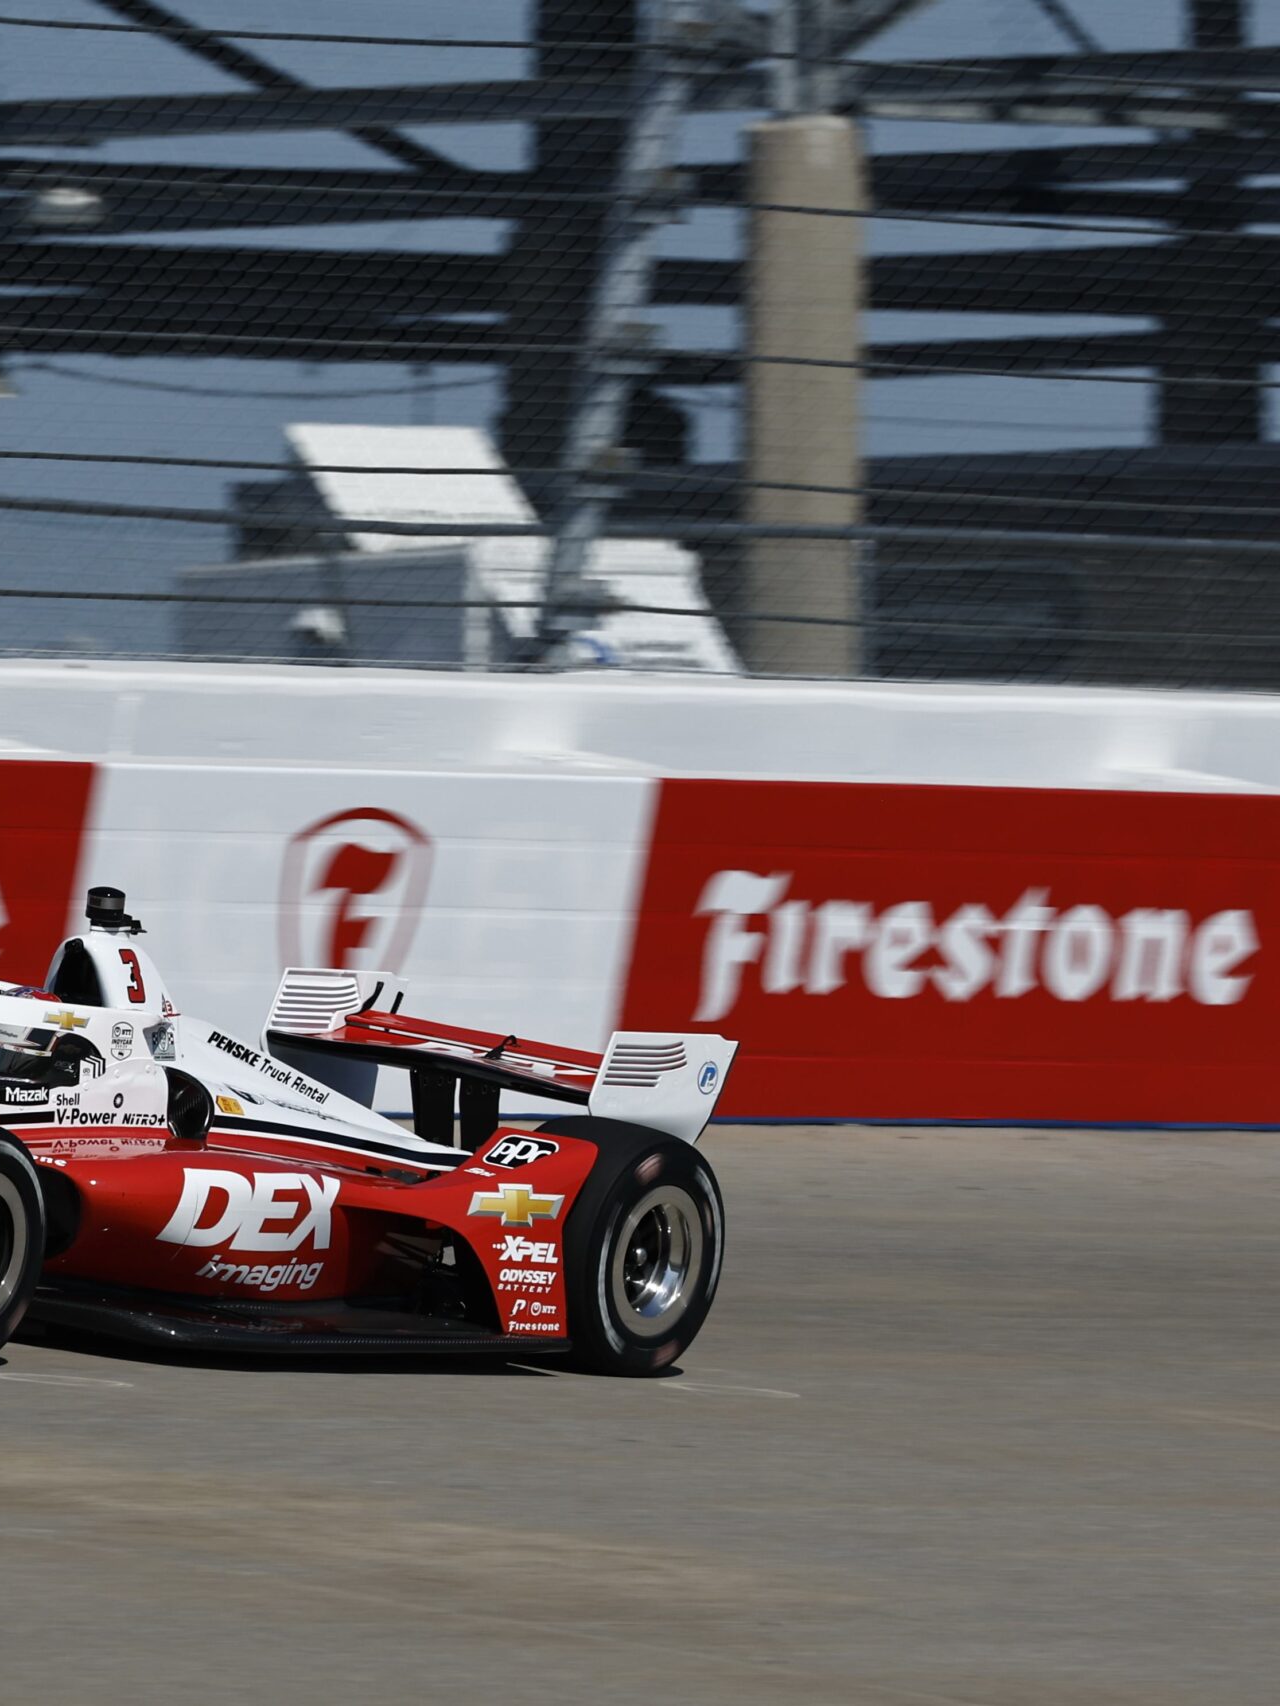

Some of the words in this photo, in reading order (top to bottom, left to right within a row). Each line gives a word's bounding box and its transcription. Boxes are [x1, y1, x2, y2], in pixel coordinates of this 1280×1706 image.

[692, 870, 1261, 1021] Firestone
[118, 948, 146, 1004] 3
[207, 1031, 261, 1067] PENSKE
[260, 1058, 291, 1085] Truck
[291, 1076, 330, 1105] Rental
[5, 1086, 49, 1102] Mazak
[56, 1093, 80, 1105] Shell
[56, 1109, 117, 1125] V-Power
[155, 1167, 341, 1252] DEX
[499, 1235, 559, 1264] XPEL
[195, 1254, 324, 1292] imaging
[499, 1268, 556, 1285] ODYSSEY
[497, 1283, 551, 1294] BATTERY
[541, 1305, 557, 1314] NTT
[508, 1320, 560, 1332] Firestone
